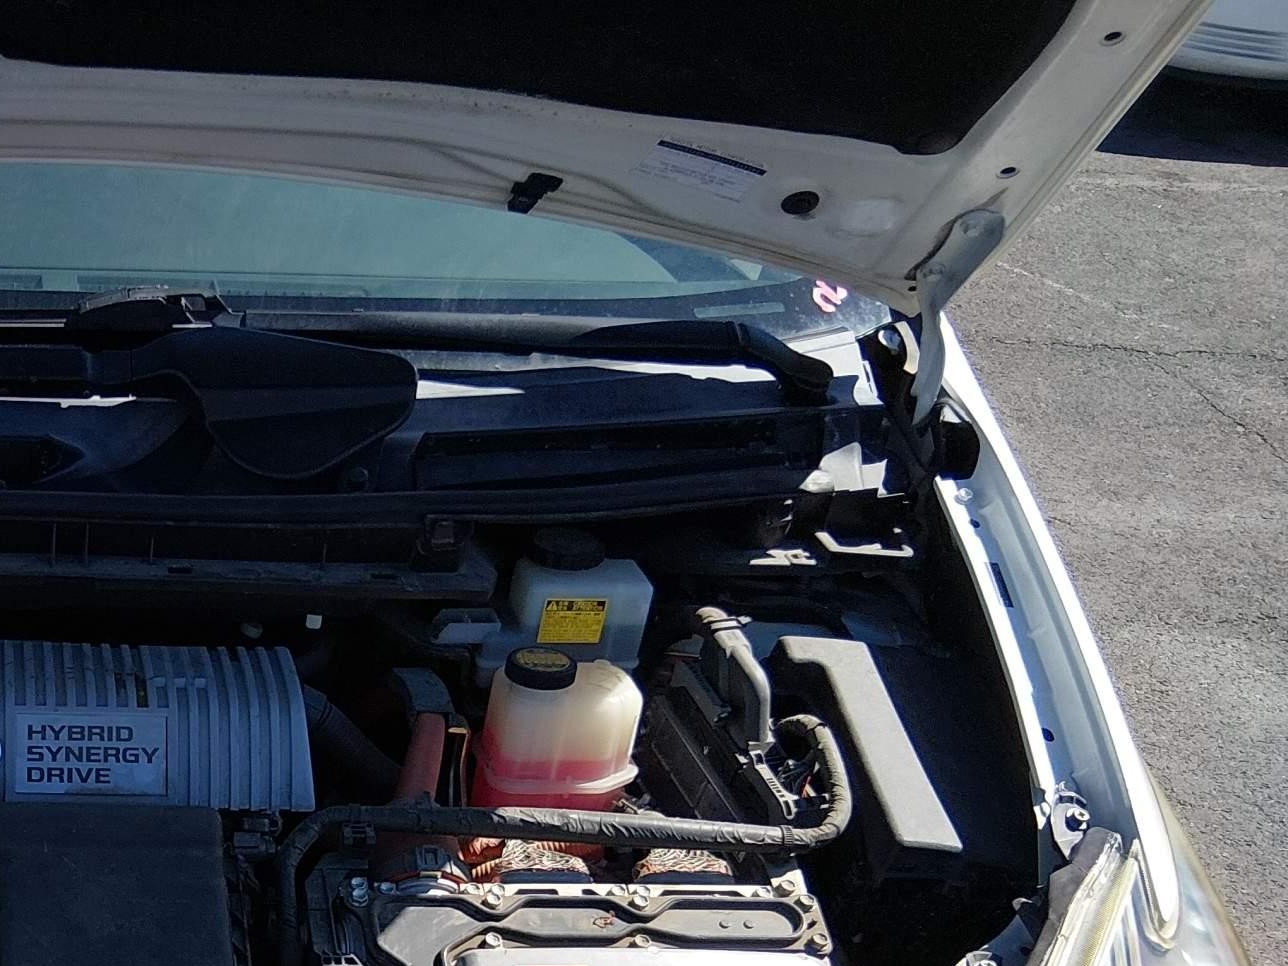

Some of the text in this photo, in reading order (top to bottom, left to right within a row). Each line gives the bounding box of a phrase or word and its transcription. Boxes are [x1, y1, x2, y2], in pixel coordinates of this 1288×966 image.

[27, 724, 134, 742] HYBRID
[26, 745, 160, 764] SYNERGY
[26, 767, 111, 784] DRIVE
